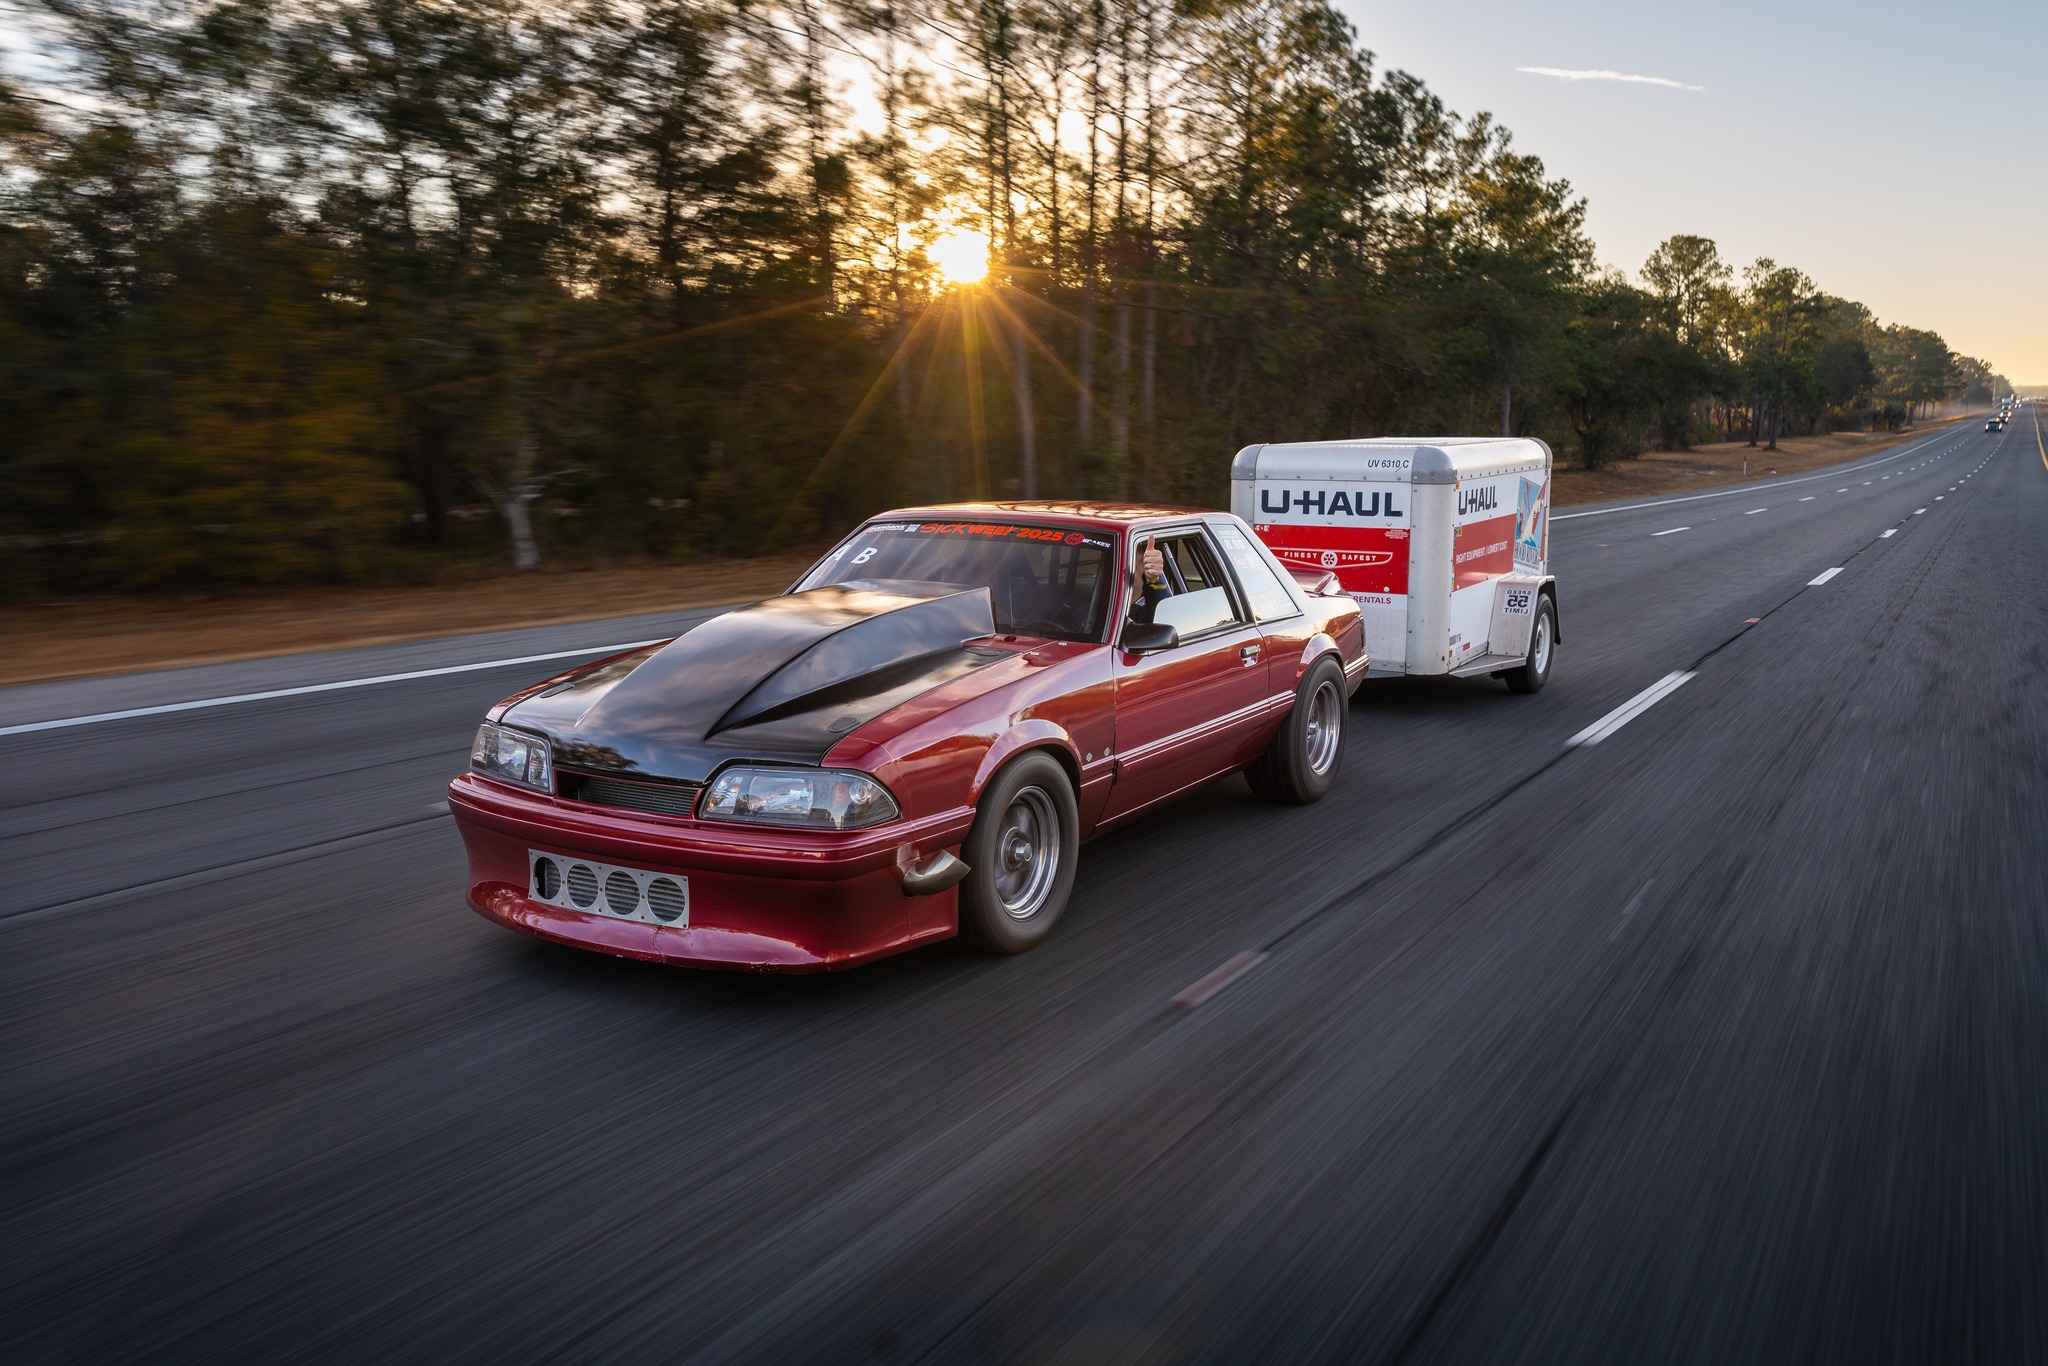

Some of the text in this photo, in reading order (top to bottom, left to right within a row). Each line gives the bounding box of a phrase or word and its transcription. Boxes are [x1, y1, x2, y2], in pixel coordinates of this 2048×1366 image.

[1368, 459, 1410, 468] UV 6310 C
[1261, 489, 1403, 517] U-HAUL
[1458, 485, 1498, 515] U-HAUL
[920, 522, 971, 535] SICK
[968, 524, 1019, 536] WEEK
[1016, 527, 1065, 542] 2025
[850, 547, 878, 565] B
[1284, 551, 1318, 559] FINEST
[1353, 595, 1392, 605] RENTALS
